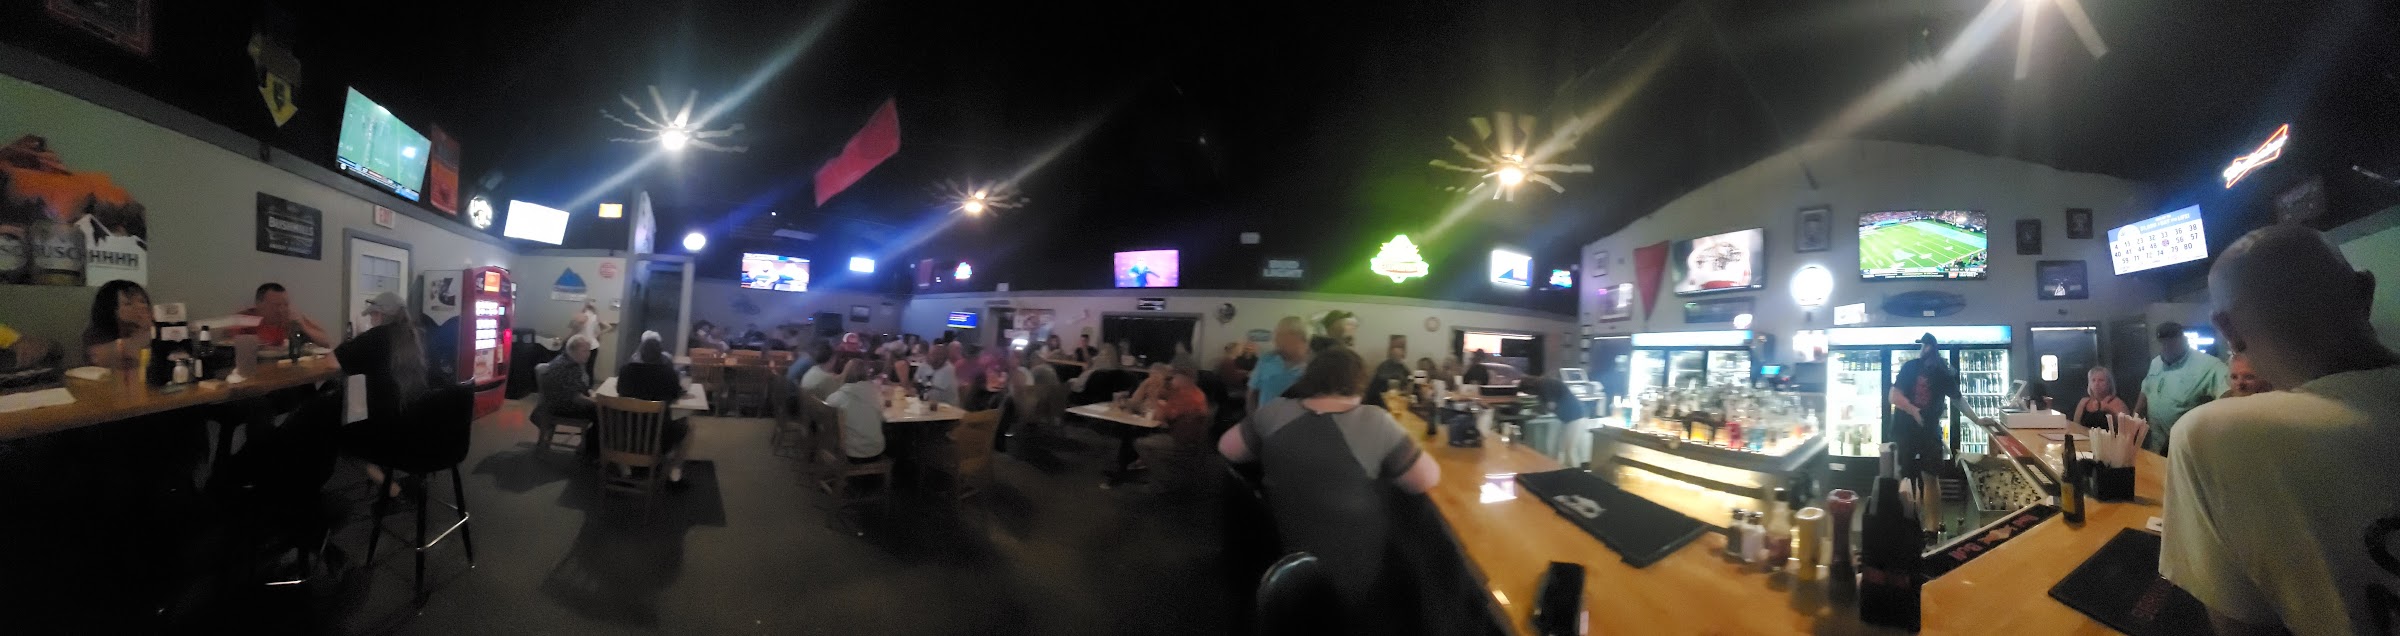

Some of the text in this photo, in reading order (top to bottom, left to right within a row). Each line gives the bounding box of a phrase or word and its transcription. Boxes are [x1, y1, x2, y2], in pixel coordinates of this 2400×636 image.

[2149, 234, 2156, 242] 32
[2161, 231, 2168, 239] 33
[2189, 224, 2197, 232] 38
[2183, 242, 2193, 250] 80
